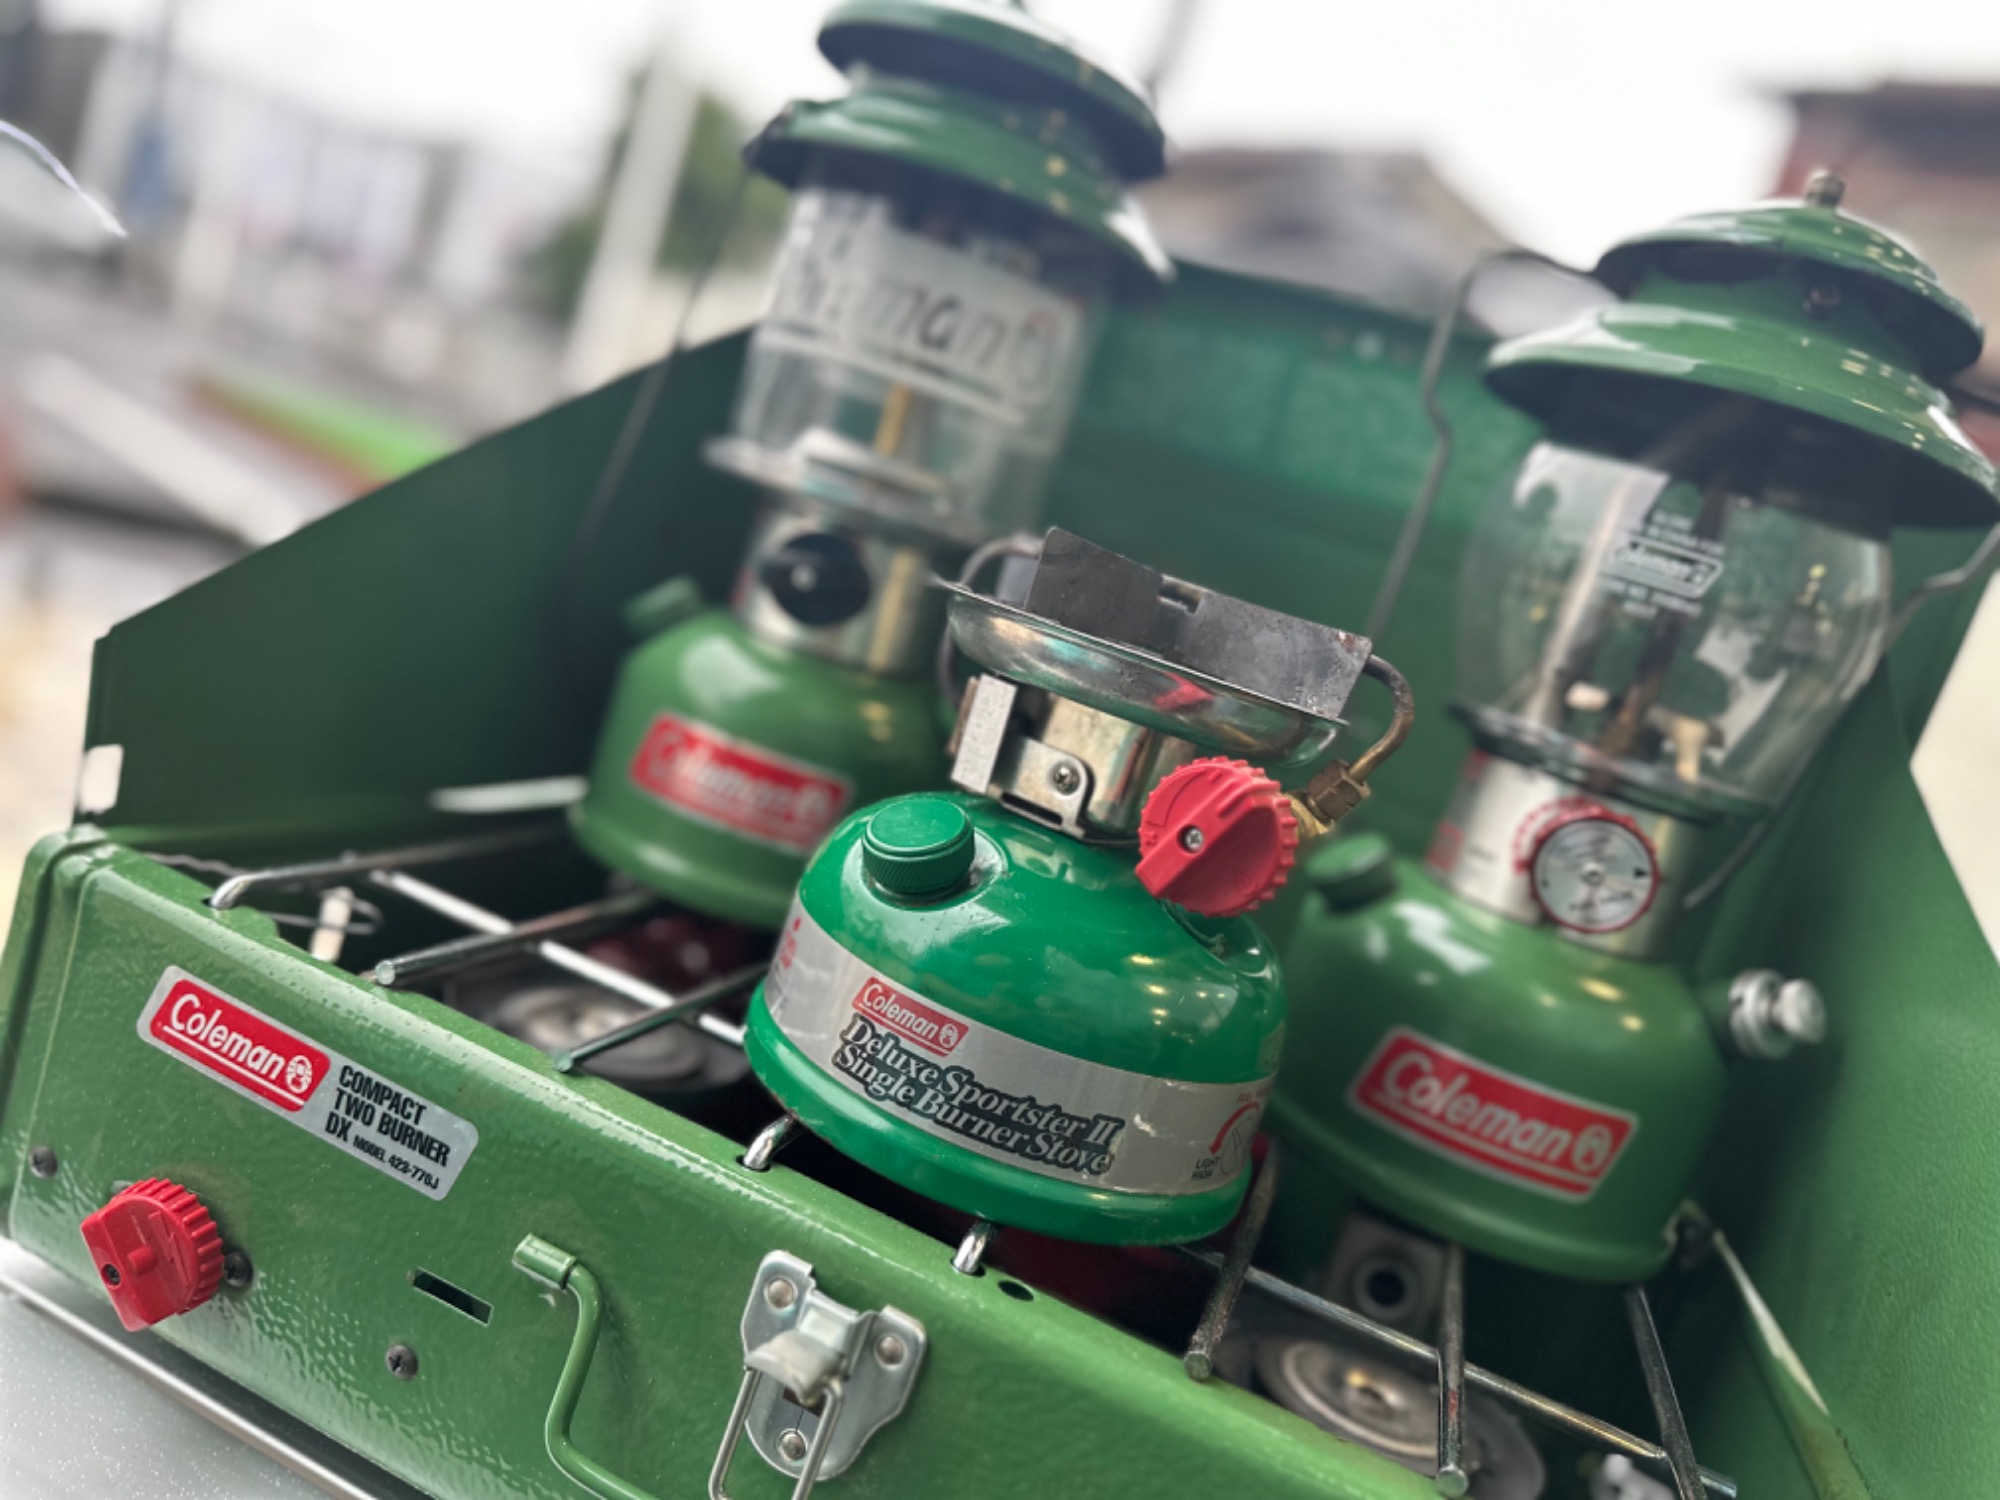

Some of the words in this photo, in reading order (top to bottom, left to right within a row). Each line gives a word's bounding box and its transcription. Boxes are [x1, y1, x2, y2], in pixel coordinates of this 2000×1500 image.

[171, 993, 286, 1080] Coleman
[862, 983, 939, 1041] Coleman
[338, 1065, 427, 1125] COMPACT
[836, 1042, 917, 1101] Single
[912, 1086, 1032, 1150] Burner
[1027, 1132, 1112, 1172] Stove
[844, 1015, 940, 1085] Deluxe
[939, 1070, 1087, 1138] Sportster
[1082, 1118, 1120, 1146] II
[1383, 1051, 1572, 1162] Coleman
[325, 1111, 352, 1142] DX
[353, 1134, 386, 1163] MODEL
[334, 1087, 376, 1127] TWO
[377, 1111, 451, 1167] BURNER
